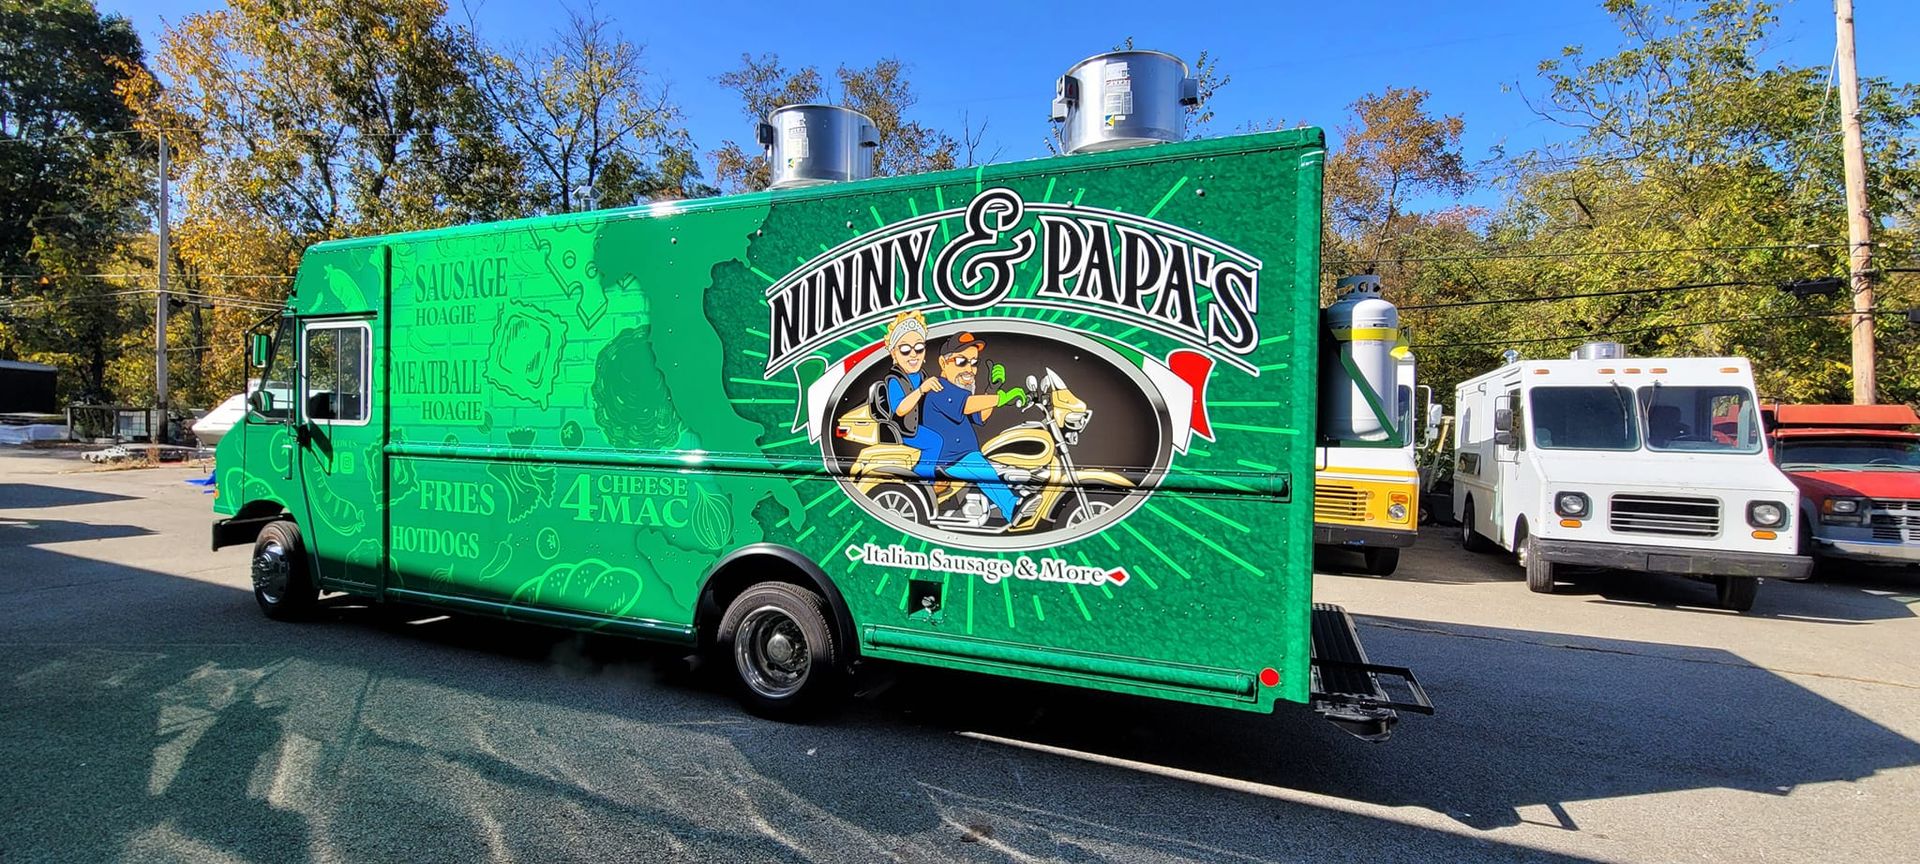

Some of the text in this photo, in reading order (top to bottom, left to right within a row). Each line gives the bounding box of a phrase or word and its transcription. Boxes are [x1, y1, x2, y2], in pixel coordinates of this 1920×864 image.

[415, 257, 508, 303] SAUSAGE
[767, 187, 1259, 367] NINNY & PAPA'S
[416, 304, 476, 327] HOAGIE
[393, 359, 482, 394] MEATBALL
[422, 400, 482, 421] HOAGIE
[419, 479, 495, 516] FRIES
[559, 473, 688, 521] 4 CHEESE
[598, 495, 689, 528] MAC
[391, 525, 480, 559] HOTDOGS
[866, 545, 1103, 583] Italian Sausage & More
